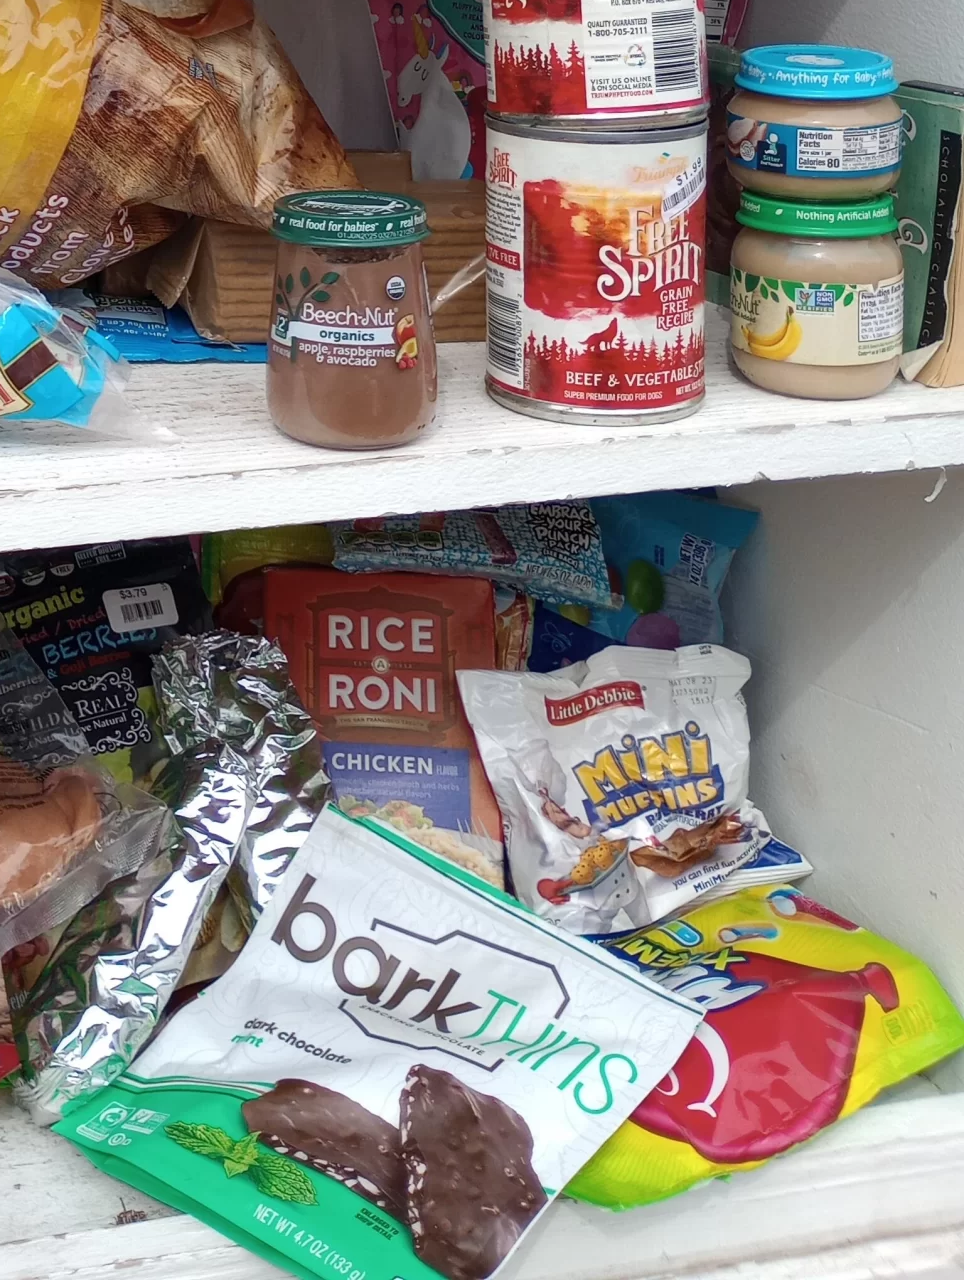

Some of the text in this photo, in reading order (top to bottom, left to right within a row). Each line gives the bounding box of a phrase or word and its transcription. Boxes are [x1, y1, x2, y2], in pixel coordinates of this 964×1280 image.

[587, 17, 648, 29] QUALITY GUARANTEED
[587, 26, 648, 37] 1-800-705-2111
[590, 78, 610, 86] VISIT
[624, 75, 652, 84] ONLINE
[609, 82, 653, 91] SOCIAL MEDIA
[776, 70, 828, 87] Anything
[833, 70, 849, 85] for
[799, 131, 833, 140] Nutrition
[799, 140, 821, 148] Facts
[492, 147, 511, 168] FREE
[763, 155, 781, 164] Sitter
[799, 157, 840, 169] Calories 80
[489, 166, 518, 189] SPIRIT
[676, 157, 703, 186] $1.99
[933, 134, 950, 251] SCHOLASTIC
[796, 205, 892, 224] Nothing Artificial Added
[289, 216, 343, 232] real food for
[626, 204, 691, 258] FREE
[500, 252, 518, 266] FREE
[596, 241, 703, 303] SPIRIT
[659, 285, 693, 302] GRAIN
[300, 302, 396, 326] Beech-Nut
[662, 299, 689, 314] FREE
[107, 319, 125, 328] Can
[656, 311, 694, 332] RECIPE
[319, 329, 375, 343] organics
[299, 342, 396, 358] apple, raspberries
[327, 355, 377, 367] avocado
[566, 367, 694, 388] BEEF & VEGETABLE
[564, 390, 663, 402] SUPER PREMIUM FOOD FOR DOGS
[546, 517, 583, 532] YOUR
[534, 527, 590, 549] PUNCH
[547, 539, 580, 555] PACK
[119, 587, 148, 601] $3.79
[326, 615, 434, 654] RICE
[328, 673, 436, 713] RONI
[74, 695, 128, 720] REAL
[551, 689, 637, 721] Little Debbie
[93, 713, 127, 730] Natural
[331, 752, 434, 776] CHICKEN
[437, 784, 460, 792] herbs
[672, 857, 736, 891] you can find fun
[244, 1017, 353, 1066] dark chocolate
[416, 1027, 485, 1057] CHOCOLATE
[253, 1203, 353, 1275] NET WT 4.7 OZ (133
